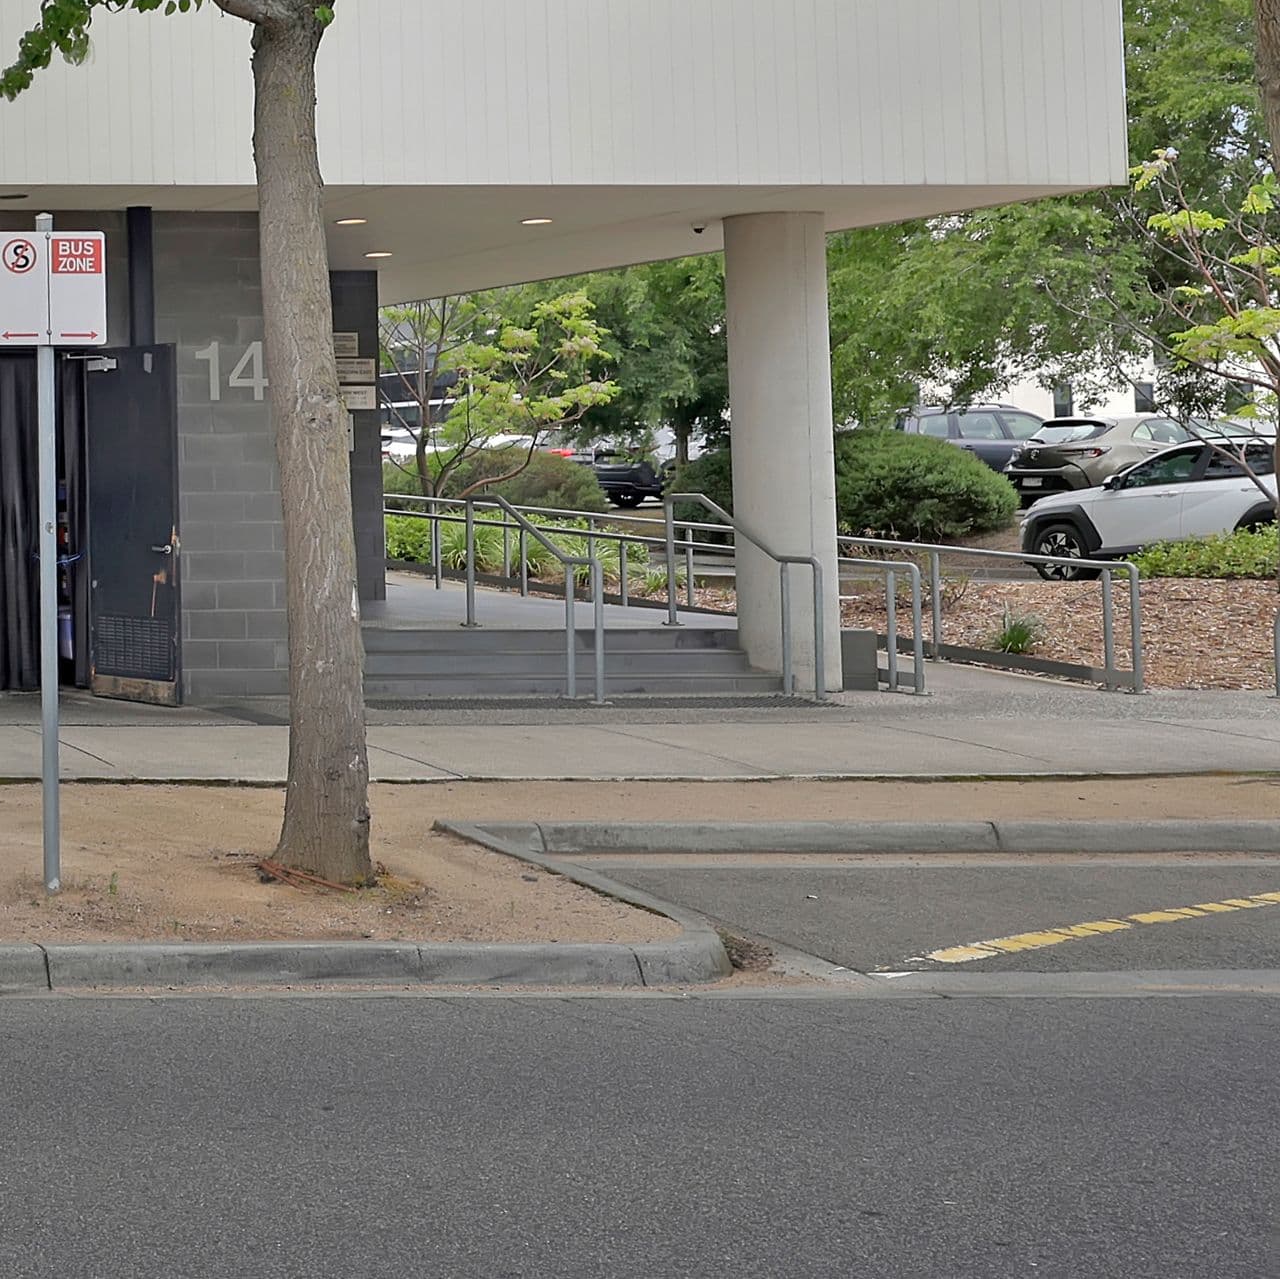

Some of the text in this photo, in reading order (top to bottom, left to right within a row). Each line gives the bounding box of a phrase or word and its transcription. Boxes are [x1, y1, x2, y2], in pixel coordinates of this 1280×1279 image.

[58, 241, 94, 255] BUS
[58, 257, 96, 272] ZONE
[195, 341, 269, 401] 14
